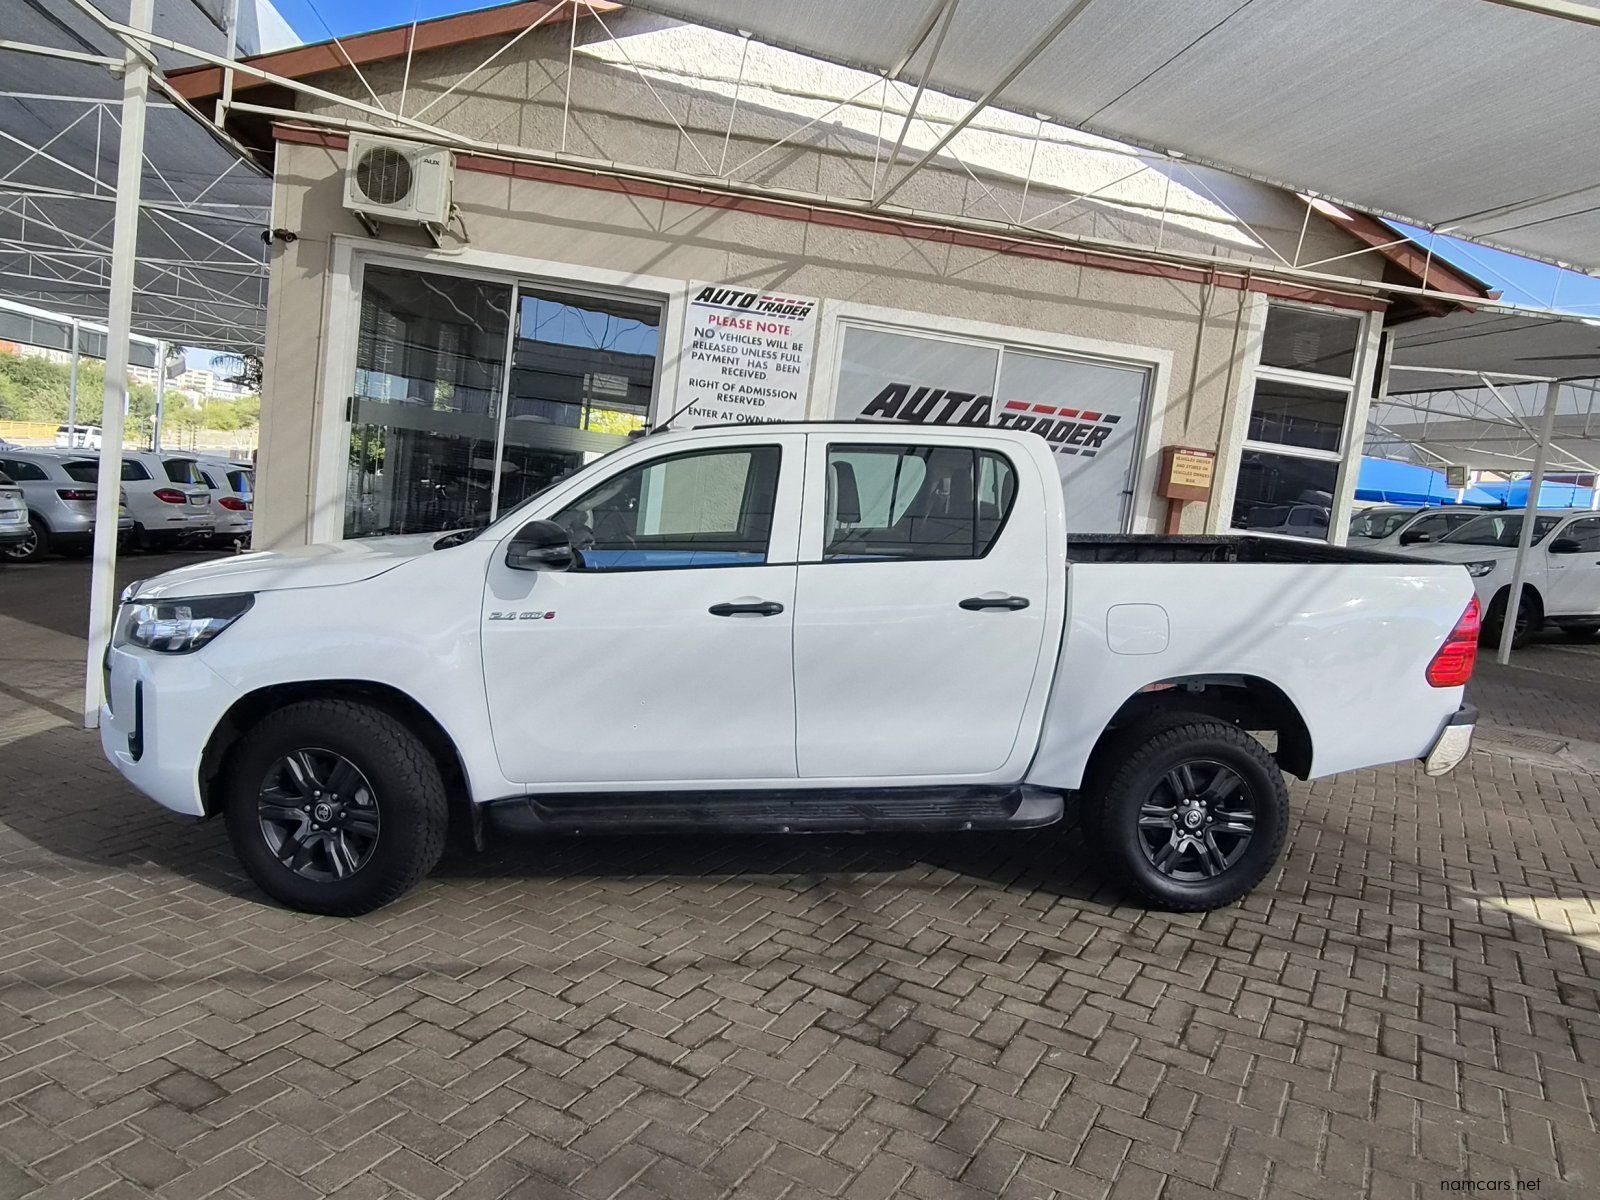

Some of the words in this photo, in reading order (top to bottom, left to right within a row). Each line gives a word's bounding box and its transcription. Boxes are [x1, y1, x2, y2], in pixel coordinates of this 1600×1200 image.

[694, 286, 758, 308] AUTO
[756, 302, 812, 317] TRADER
[708, 314, 752, 330] PLEASE
[756, 321, 793, 336] NOTE:
[694, 327, 715, 339] NO
[719, 331, 762, 346] VEHICLES
[766, 337, 788, 350] WILL
[792, 342, 803, 352] BE
[691, 351, 740, 366] PAYMENT
[747, 359, 768, 370] HAS
[775, 363, 800, 375] BEEN
[692, 340, 738, 354] RELEASED
[741, 347, 778, 360] UNLESS
[780, 352, 802, 364] FULL
[689, 378, 720, 390] RIGHT
[722, 382, 736, 393] OF
[738, 384, 798, 400] ADMISSION
[688, 406, 718, 419] ENTER
[720, 411, 734, 421] AT
[736, 413, 763, 424] OWN
[860, 382, 992, 426] AUTO
[996, 412, 1113, 448] TRADER
